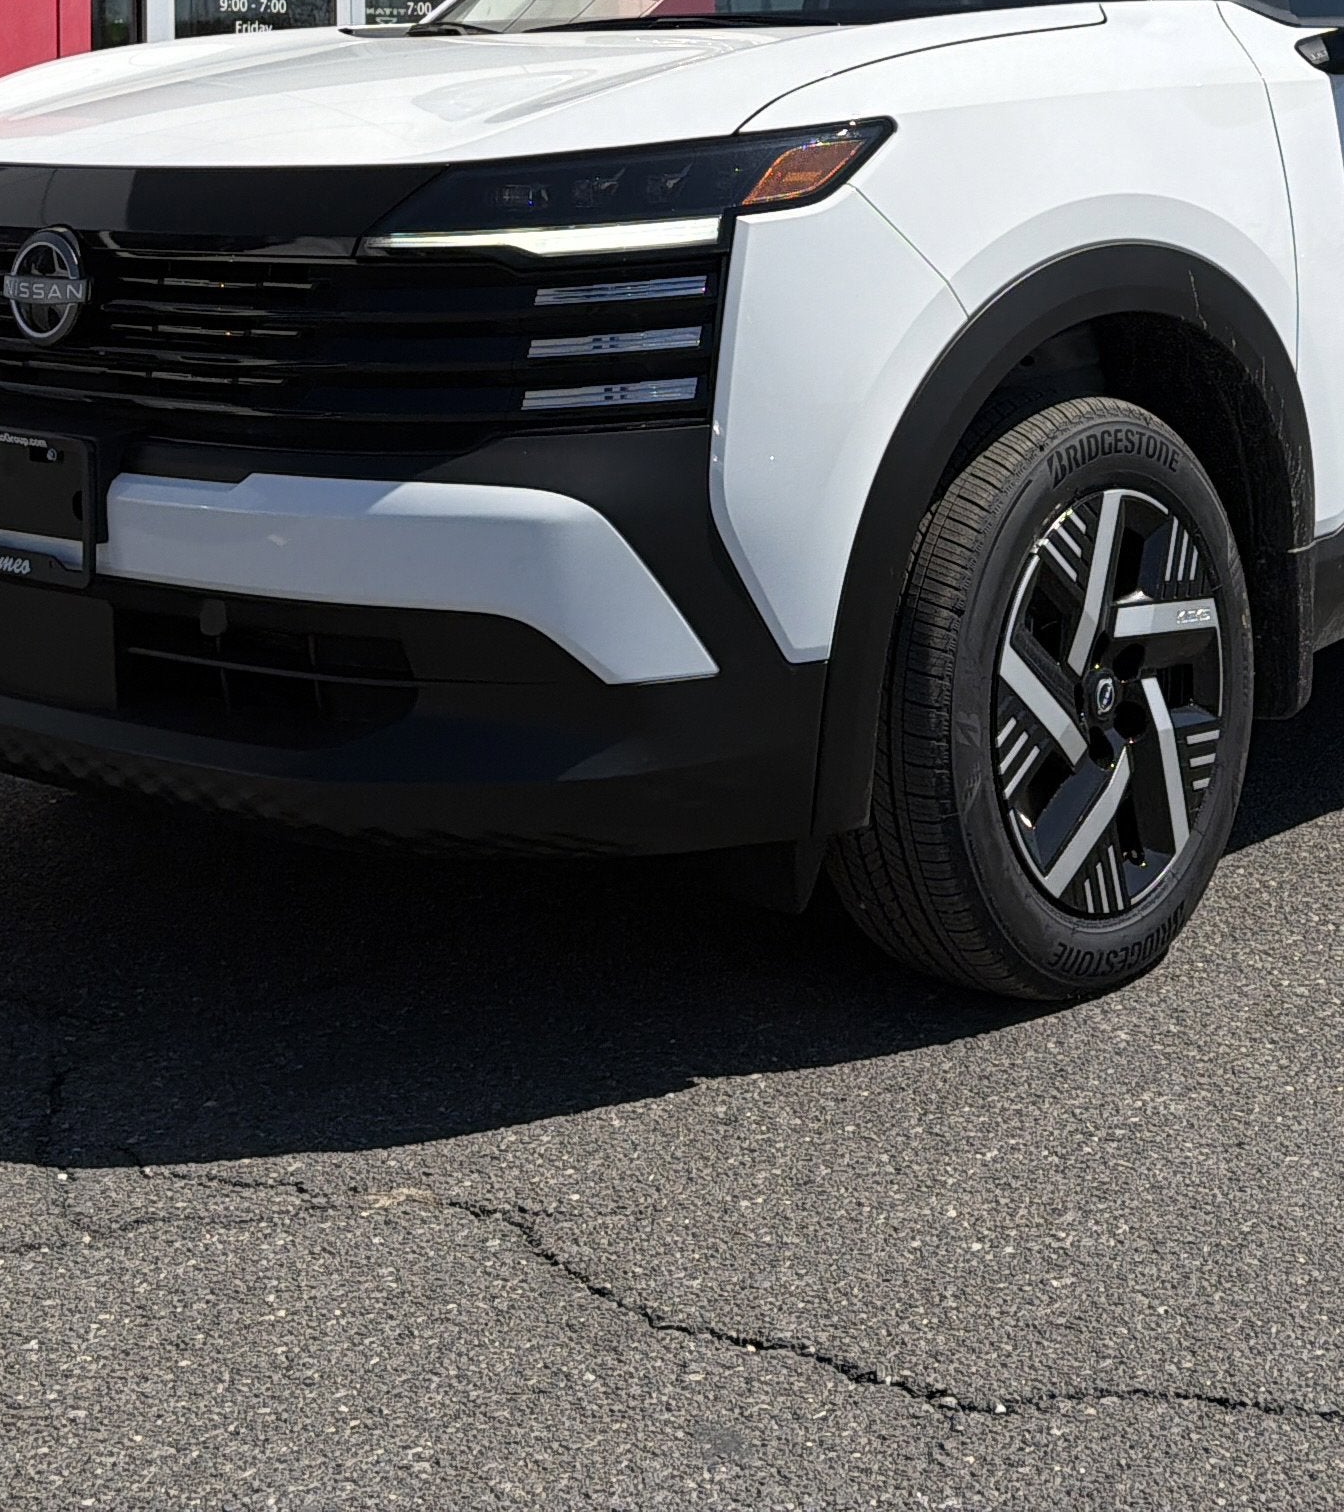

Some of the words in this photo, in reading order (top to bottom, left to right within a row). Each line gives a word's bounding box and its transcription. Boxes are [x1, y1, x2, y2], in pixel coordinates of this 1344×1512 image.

[259, 0, 287, 14] 7:00
[407, 1, 433, 16] 7:00
[235, 20, 274, 34] Friday
[5, 280, 83, 300] NISSAN
[1046, 428, 1181, 489] BRIDGESTONE
